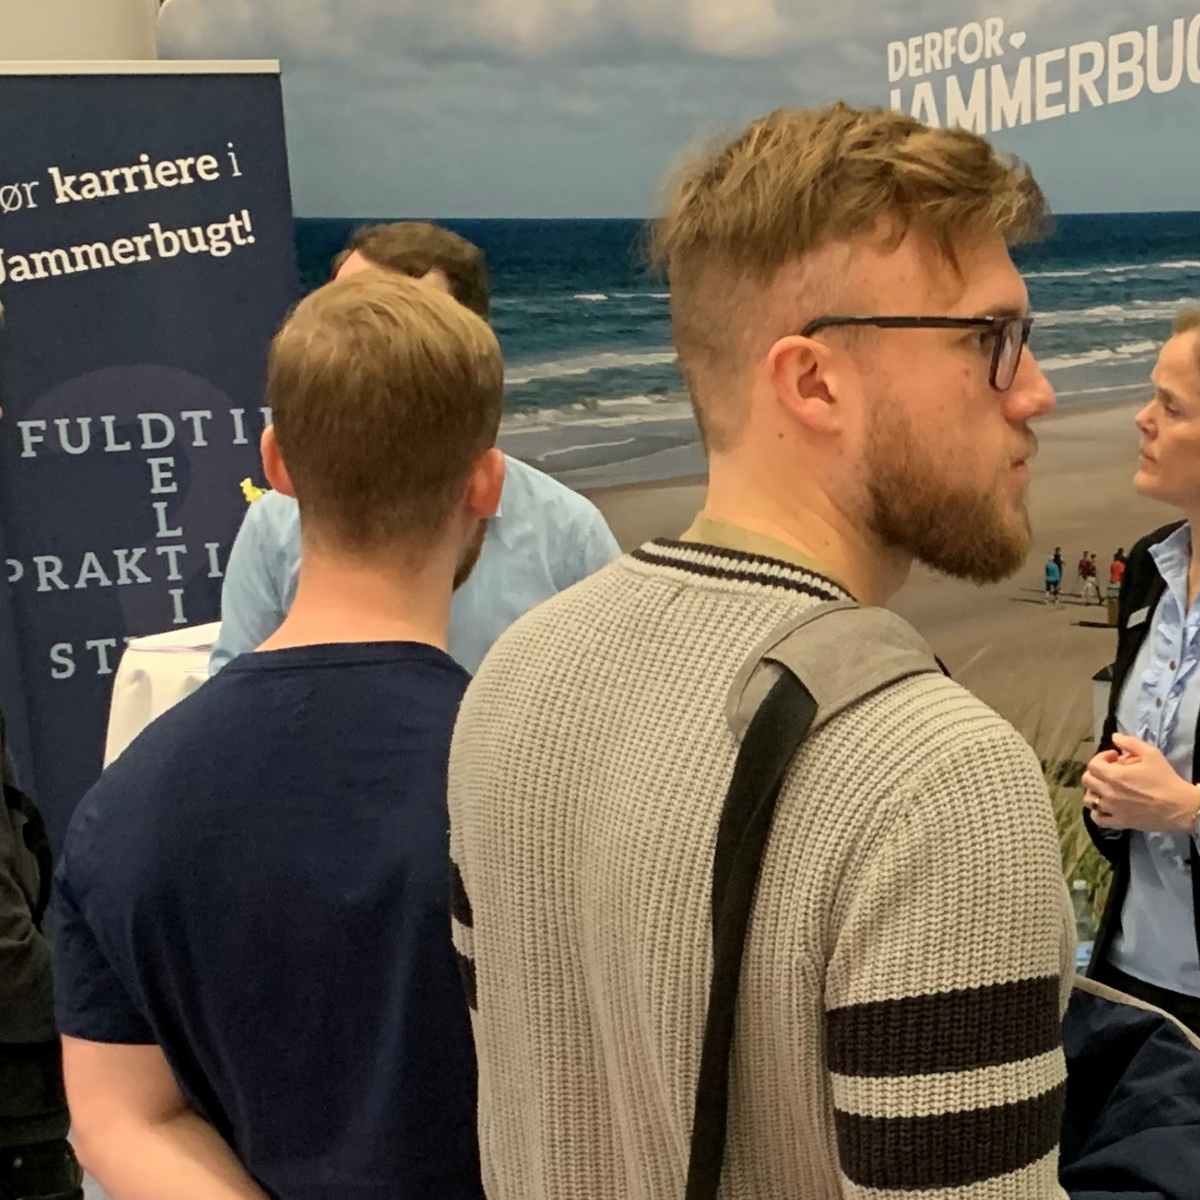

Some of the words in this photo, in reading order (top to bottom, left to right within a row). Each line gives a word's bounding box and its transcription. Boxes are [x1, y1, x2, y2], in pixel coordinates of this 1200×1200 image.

[887, 16, 1004, 83] DERFOR
[47, 153, 220, 204] karriere
[226, 142, 243, 178] i
[50, 636, 138, 680] ST
